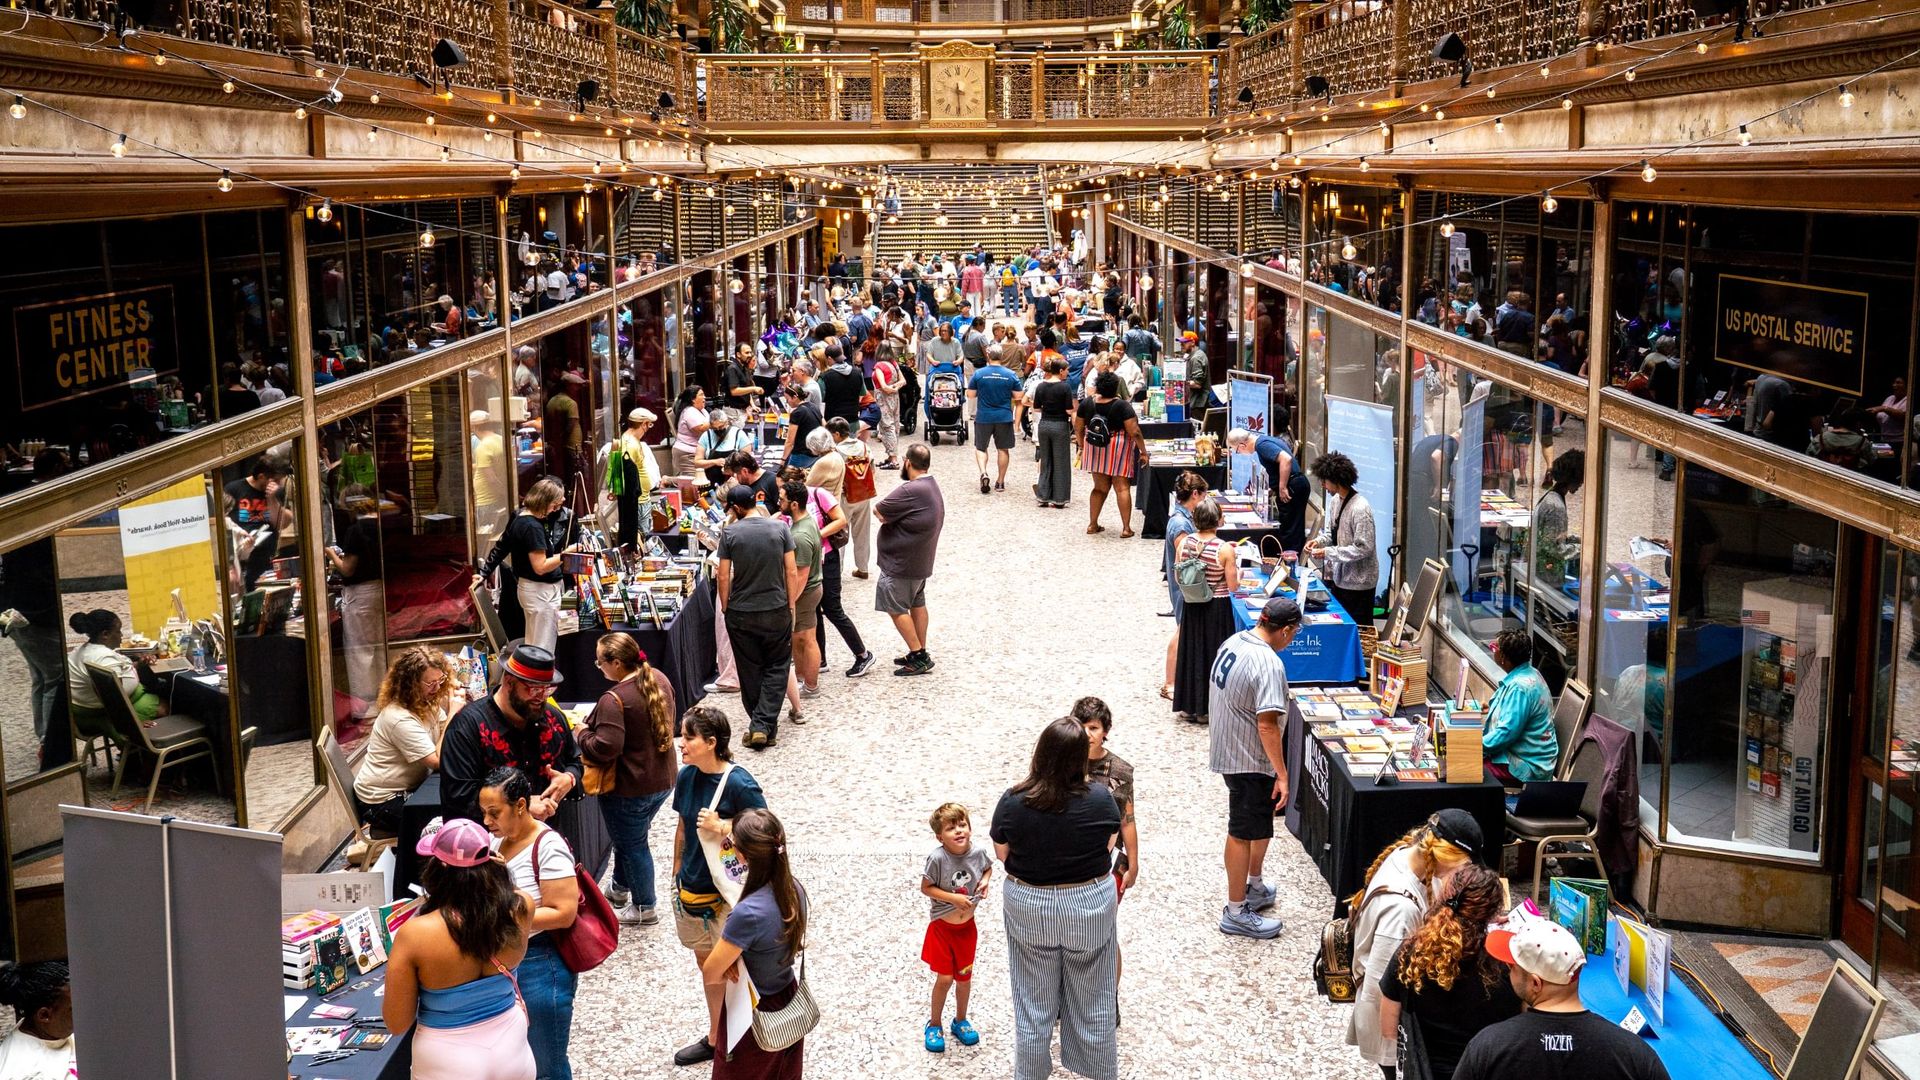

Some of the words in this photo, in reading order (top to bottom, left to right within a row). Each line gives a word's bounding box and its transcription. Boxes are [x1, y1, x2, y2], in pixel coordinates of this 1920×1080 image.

[50, 299, 150, 349] FITNESS
[1725, 308, 1741, 332] US
[1743, 311, 1791, 342] POSTAL
[1794, 320, 1854, 354] SERVICE
[56, 337, 150, 388] CENTER
[1306, 634, 1322, 647] Ink
[1212, 648, 1237, 690] 19
[1764, 671, 1778, 679] VISA
[1795, 756, 1813, 786] GIFT
[1794, 786, 1811, 814] AND
[1792, 815, 1810, 834] GO
[326, 978, 345, 992] HOME
[1544, 1034, 1573, 1051] HOZIER
